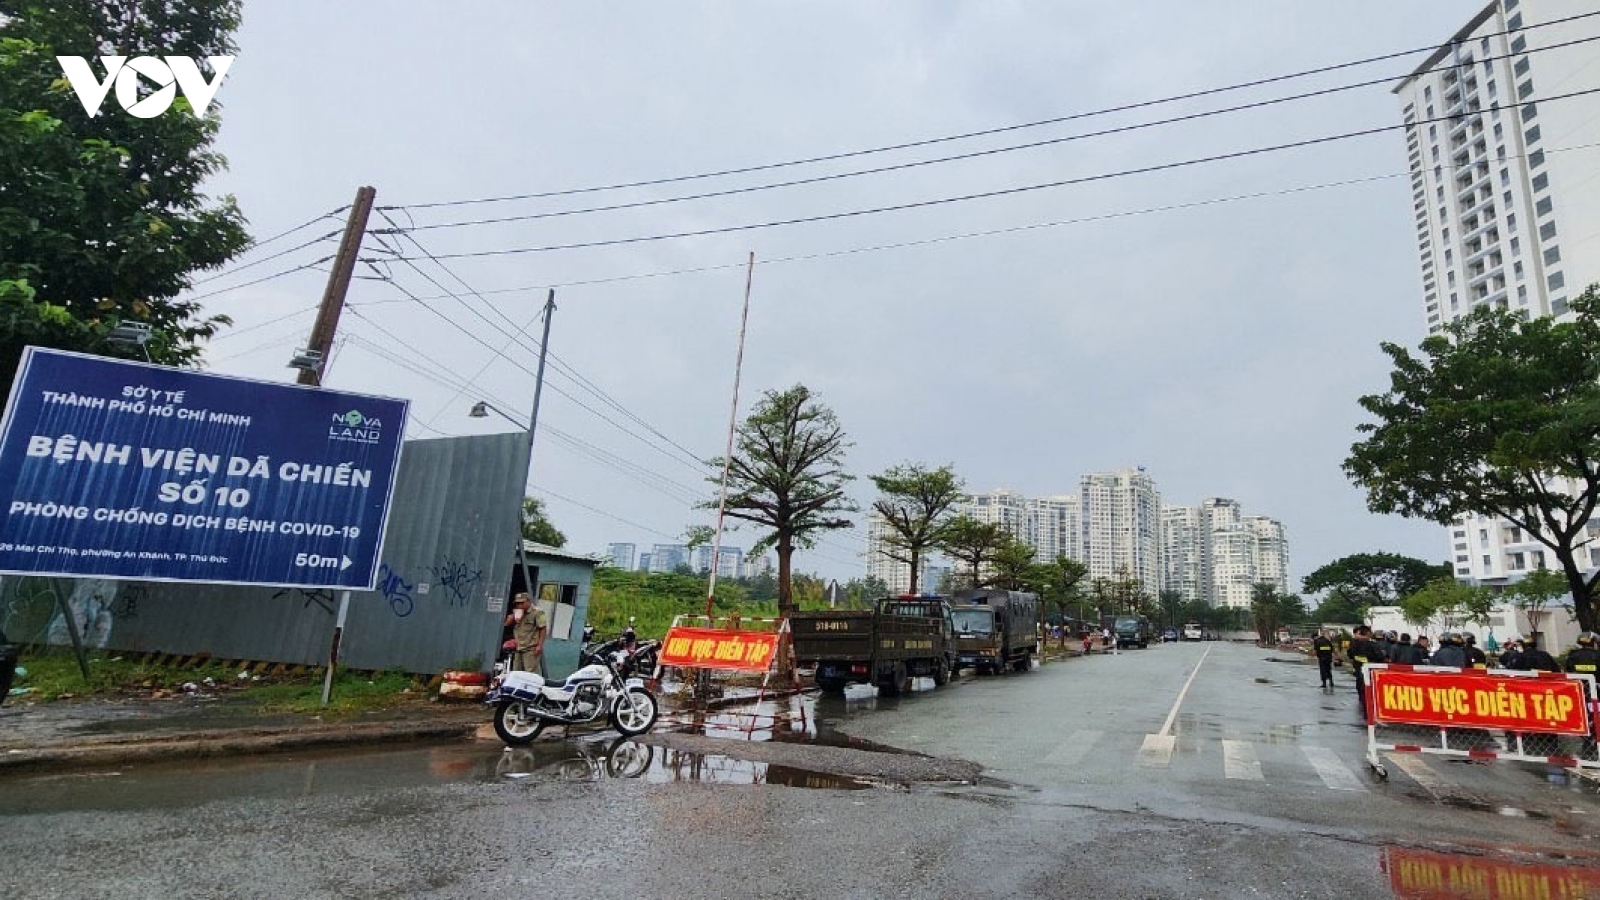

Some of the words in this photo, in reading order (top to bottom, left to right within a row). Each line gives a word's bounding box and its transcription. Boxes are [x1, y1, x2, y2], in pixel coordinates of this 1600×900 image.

[42, 391, 104, 409] THÀNH
[108, 400, 147, 414] PHỐ
[149, 404, 174, 418] HỒ
[177, 408, 207, 422] CHÍ
[208, 412, 252, 426] MINH
[122, 385, 148, 398] SỞ
[151, 389, 162, 400] Y
[164, 390, 186, 404] TẾ
[329, 426, 380, 440] LAND
[27, 434, 132, 465] BỆNH
[141, 447, 220, 476] VIỆN
[227, 455, 269, 481] DÃ
[279, 461, 372, 488] CHIẾN
[158, 478, 208, 504] SỐ
[215, 486, 250, 508] 10
[9, 501, 89, 519] PHÒNG
[93, 506, 168, 525] CHỐNG
[172, 513, 221, 530] DỊCH
[224, 516, 276, 533] BỆNH
[280, 521, 361, 538] COVID-19
[123, 550, 137, 558] An
[295, 553, 338, 568] 50m
[667, 637, 692, 656] KHU
[691, 638, 716, 662] VỰC
[715, 635, 745, 661] DIỄN
[744, 640, 770, 666] TẬP
[1383, 684, 1424, 711] KHU
[1428, 687, 1470, 719] VỰC
[1474, 683, 1526, 719] DIỄN
[1531, 688, 1574, 726] TẬP
